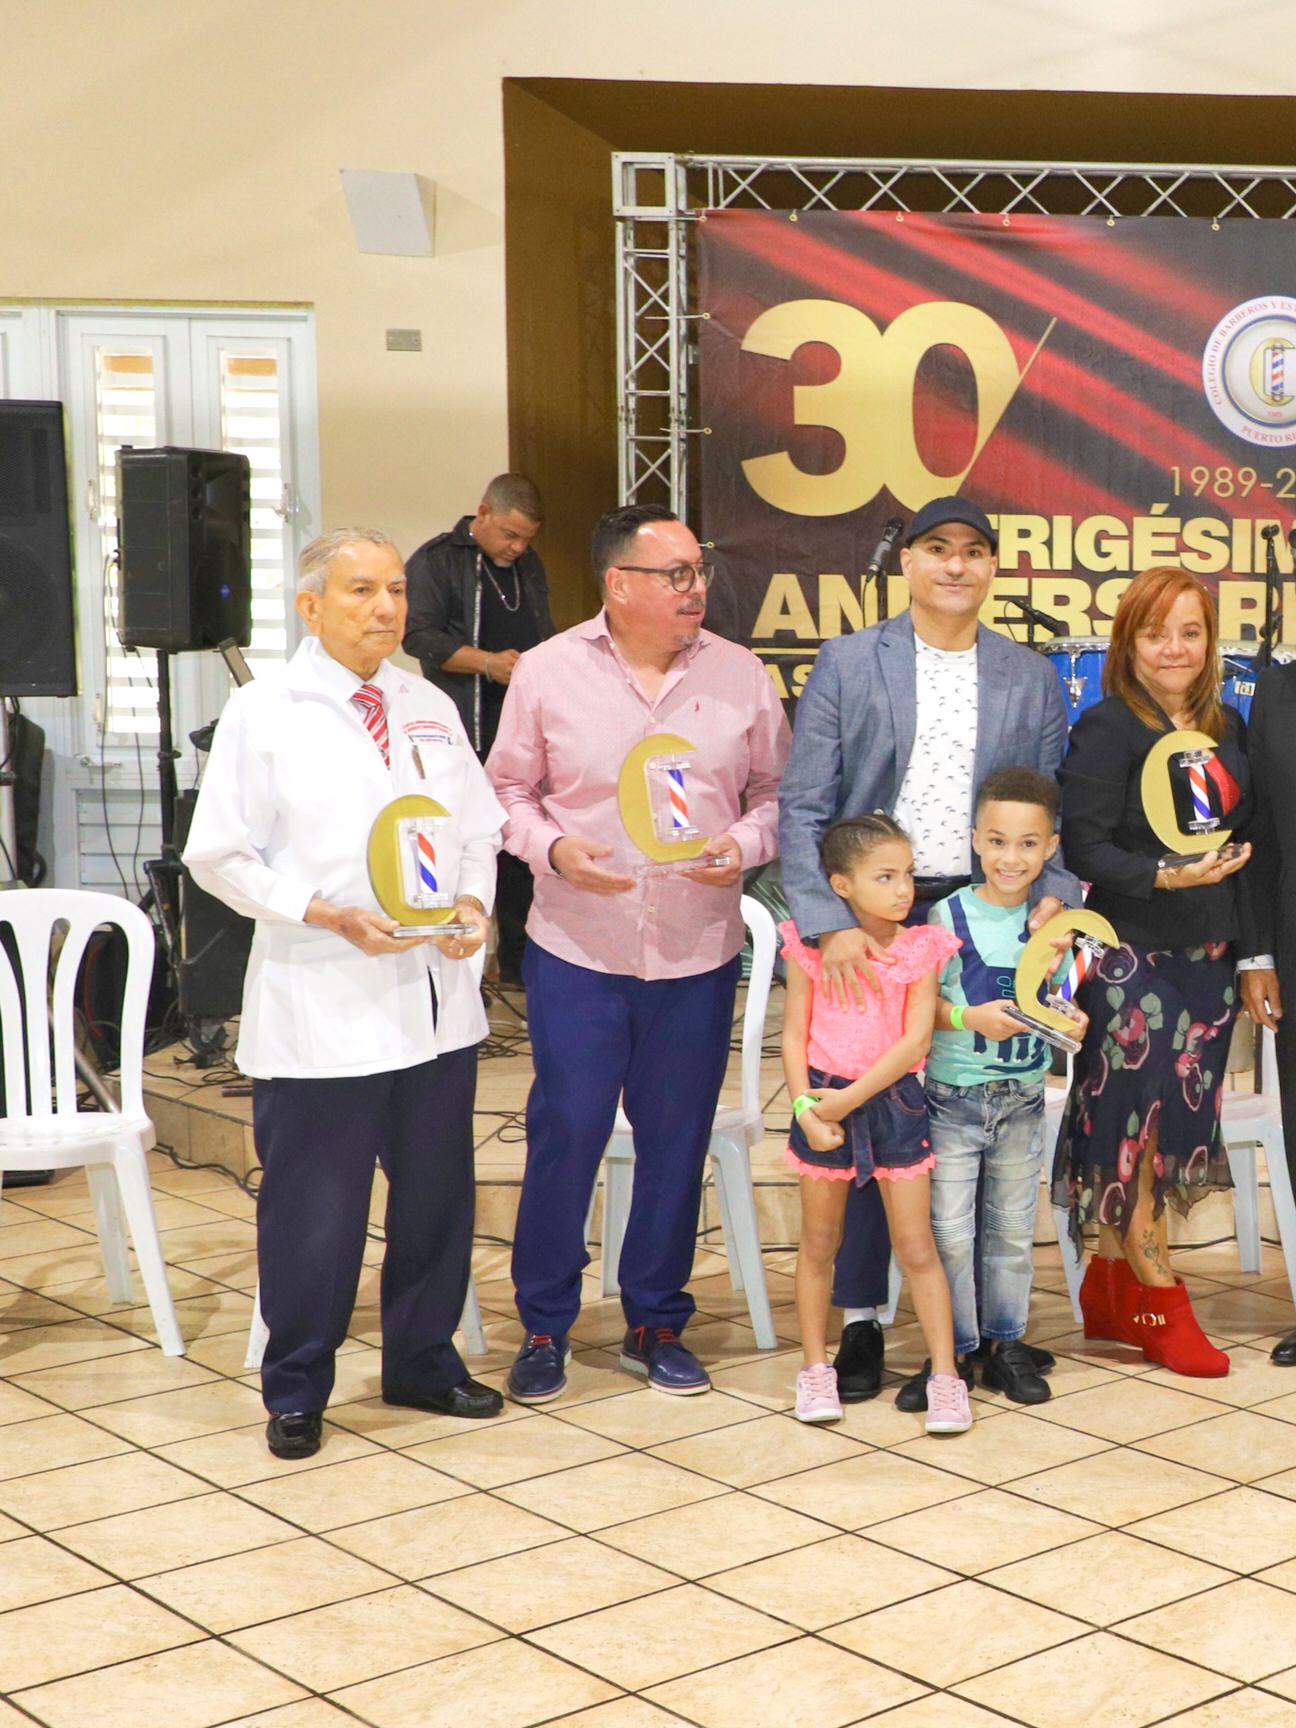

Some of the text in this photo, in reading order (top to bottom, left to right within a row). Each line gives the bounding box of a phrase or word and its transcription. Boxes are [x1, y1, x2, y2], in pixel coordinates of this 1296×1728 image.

[1219, 302, 1267, 338] BARBEROS
[1213, 340, 1221, 350] DE
[1208, 350, 1222, 405] COLEGIO
[1241, 426, 1283, 444] PUERTO
